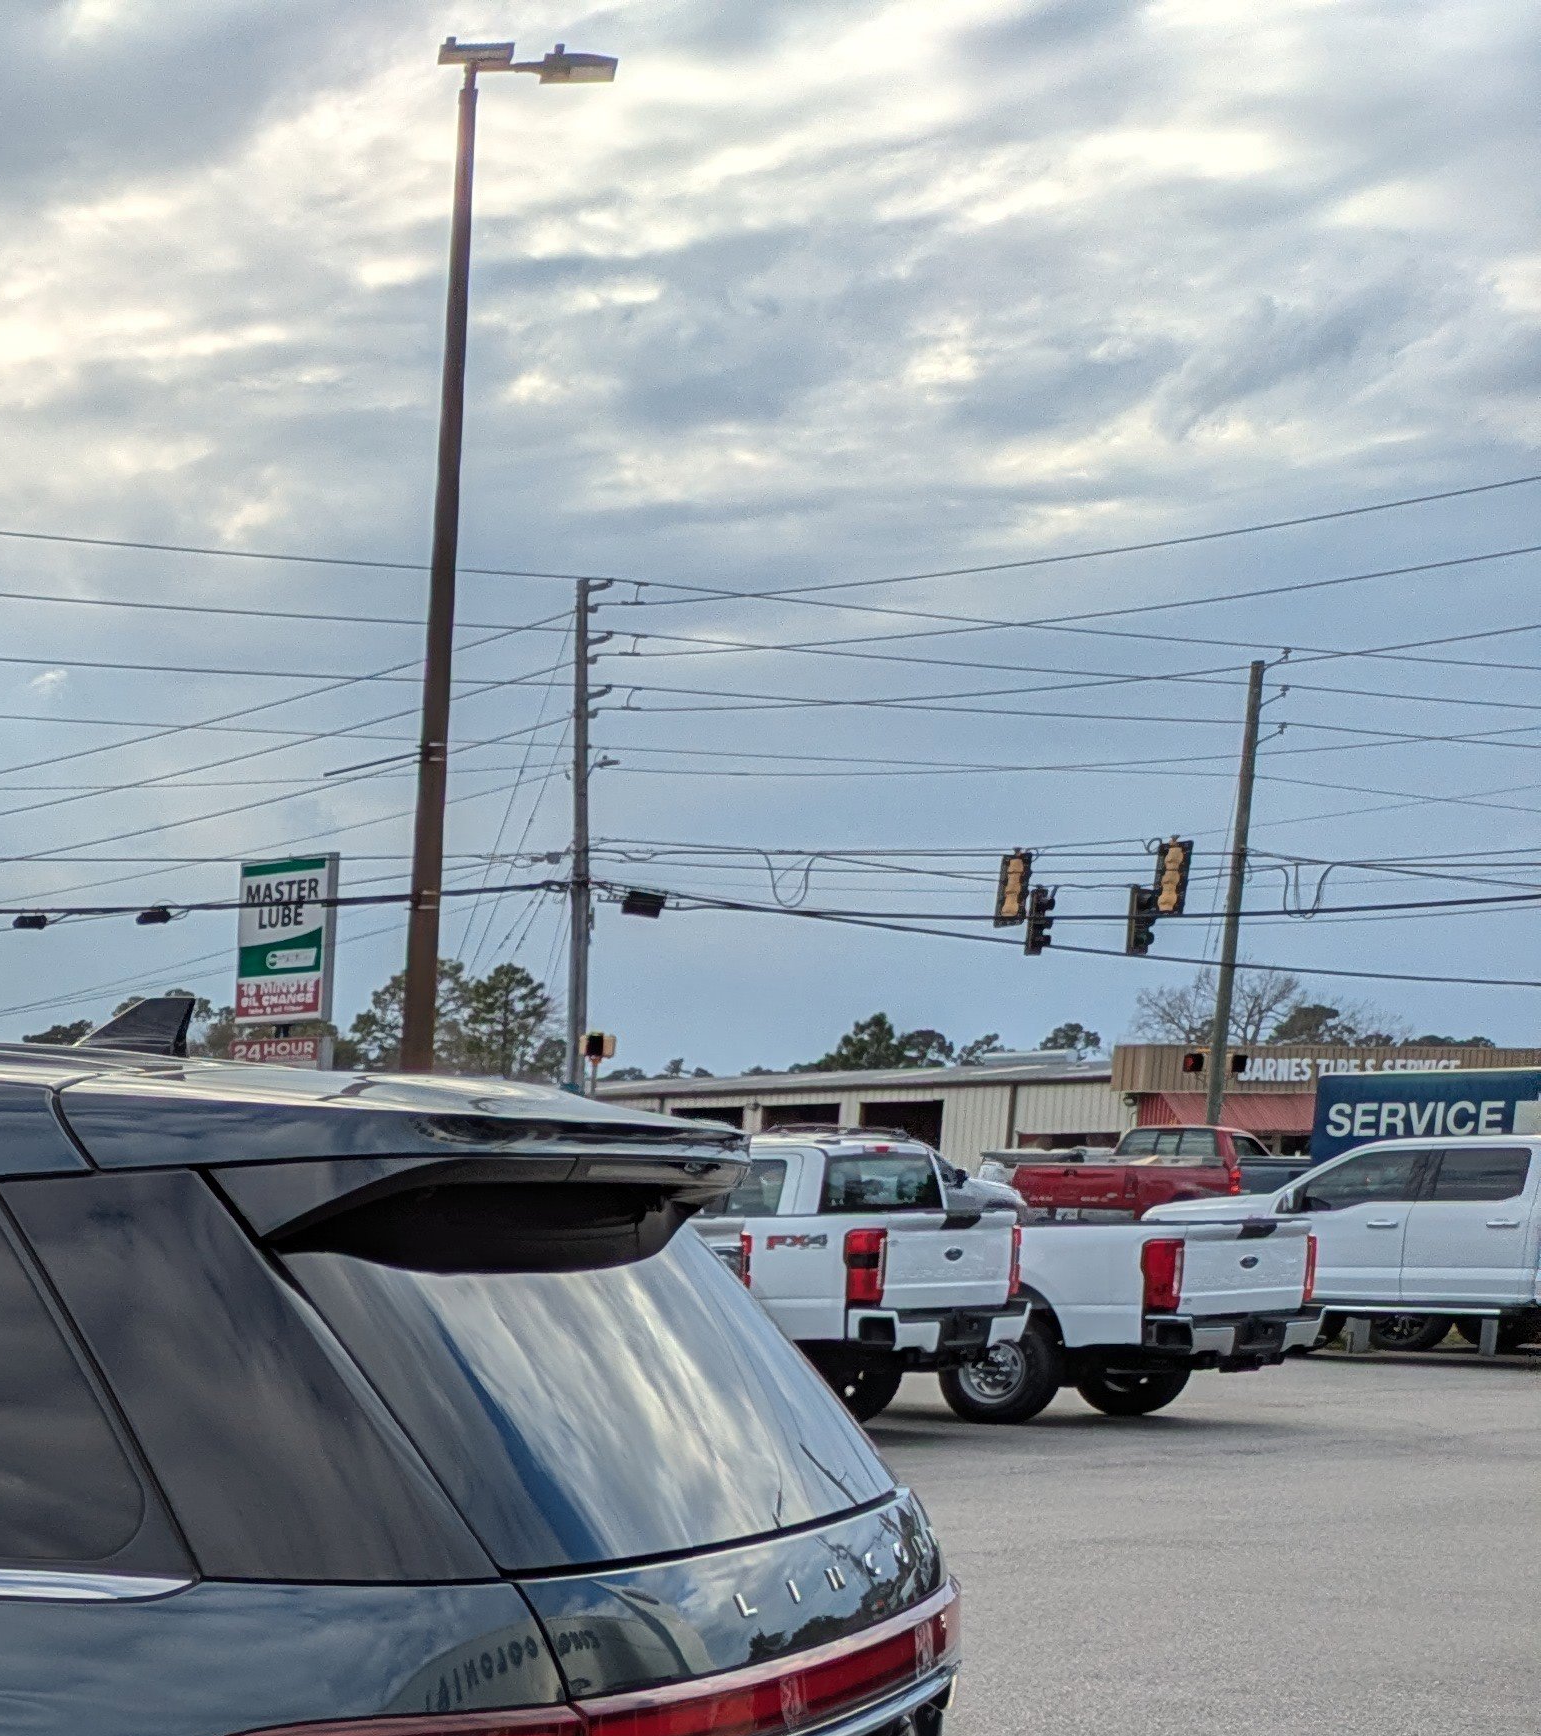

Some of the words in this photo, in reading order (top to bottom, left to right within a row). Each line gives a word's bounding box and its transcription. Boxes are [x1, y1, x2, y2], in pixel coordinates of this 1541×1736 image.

[246, 878, 319, 904] MASTER
[258, 905, 304, 930] LUBE
[259, 979, 315, 996] MINUTE
[240, 996, 259, 1008] OIL
[261, 992, 314, 1007] CHANGE
[234, 1044, 262, 1062] 24
[263, 1041, 314, 1056] HOUR
[1237, 1058, 1312, 1081] BARNES
[1316, 1059, 1361, 1075] TIRE
[1326, 1101, 1506, 1137] SERVICE
[766, 1234, 828, 1250] FX4
